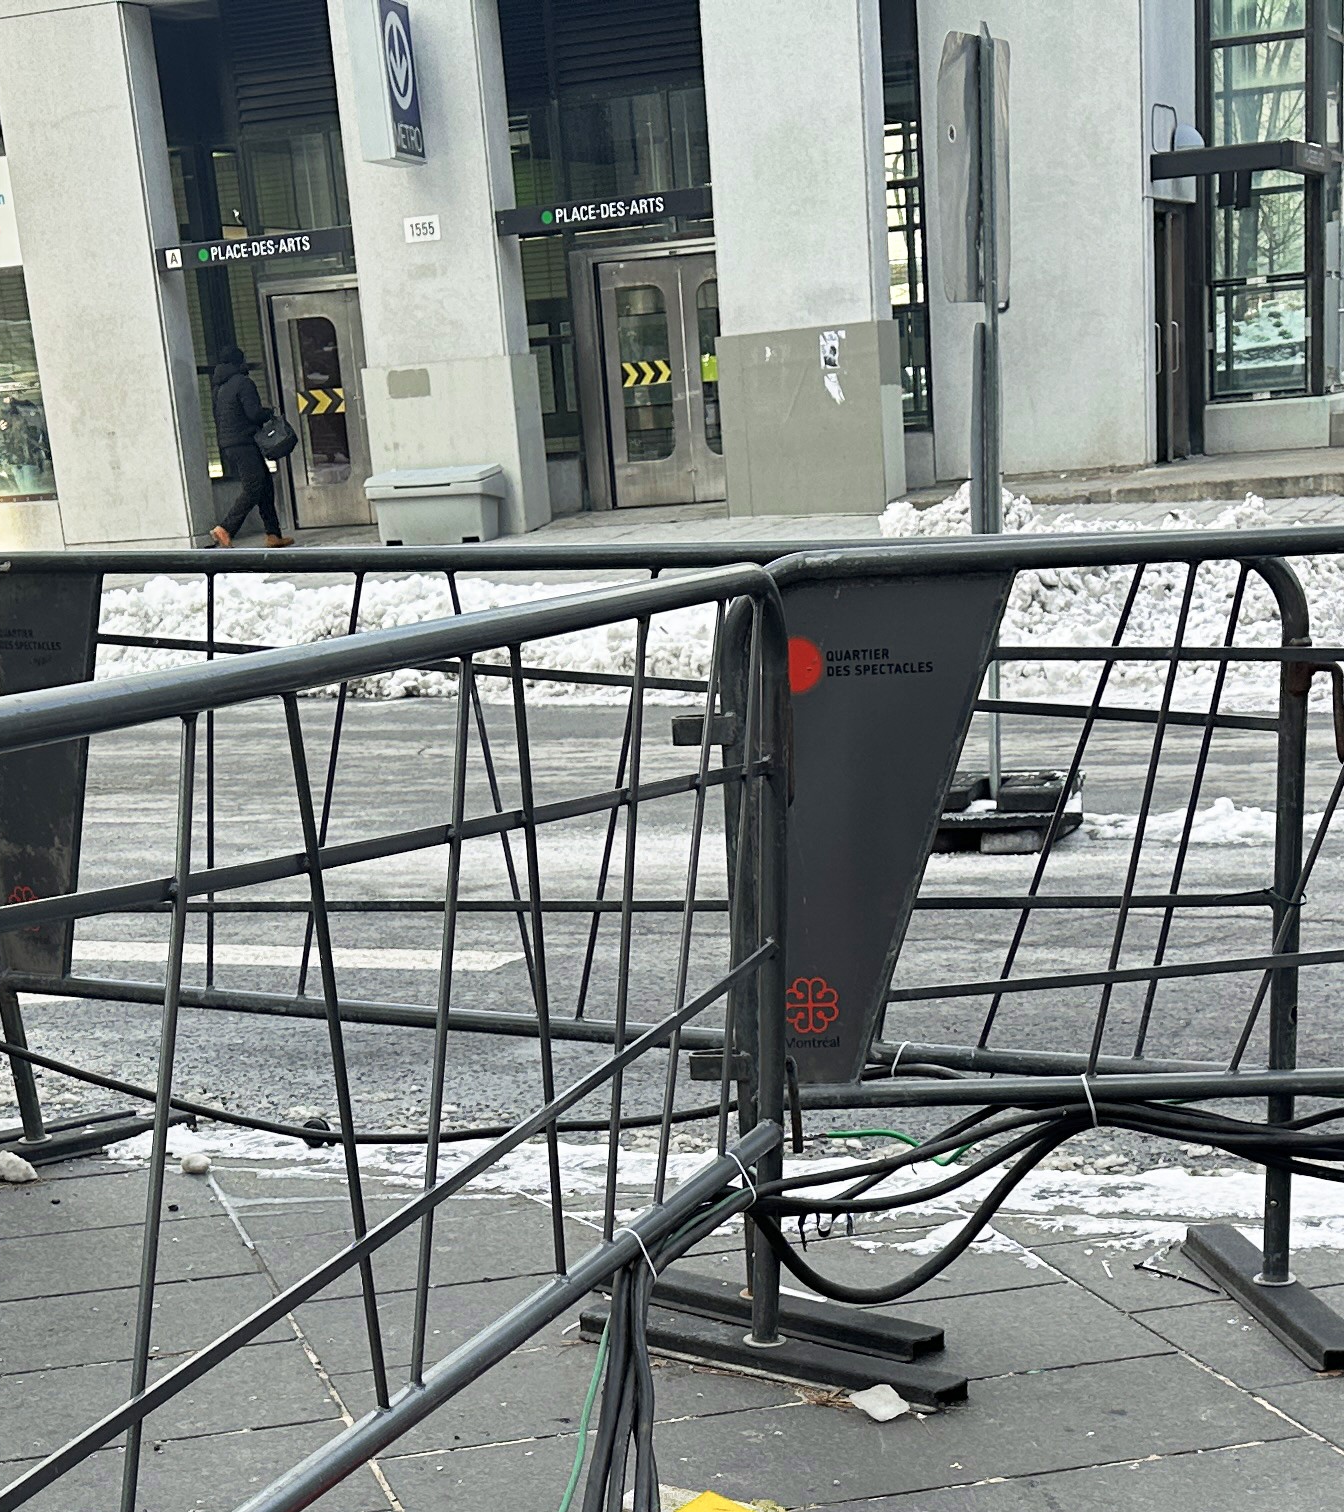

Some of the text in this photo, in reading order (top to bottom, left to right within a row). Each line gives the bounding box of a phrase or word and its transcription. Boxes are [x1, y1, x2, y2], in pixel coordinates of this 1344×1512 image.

[555, 197, 665, 224] PLACE-DES-ARTS
[409, 221, 435, 237] 1555
[170, 235, 311, 265] A PLACE-DES-ARTS
[826, 648, 890, 662] QUARTIER
[827, 661, 934, 677] DES SPECTACLES
[785, 1035, 841, 1049] Montréal
